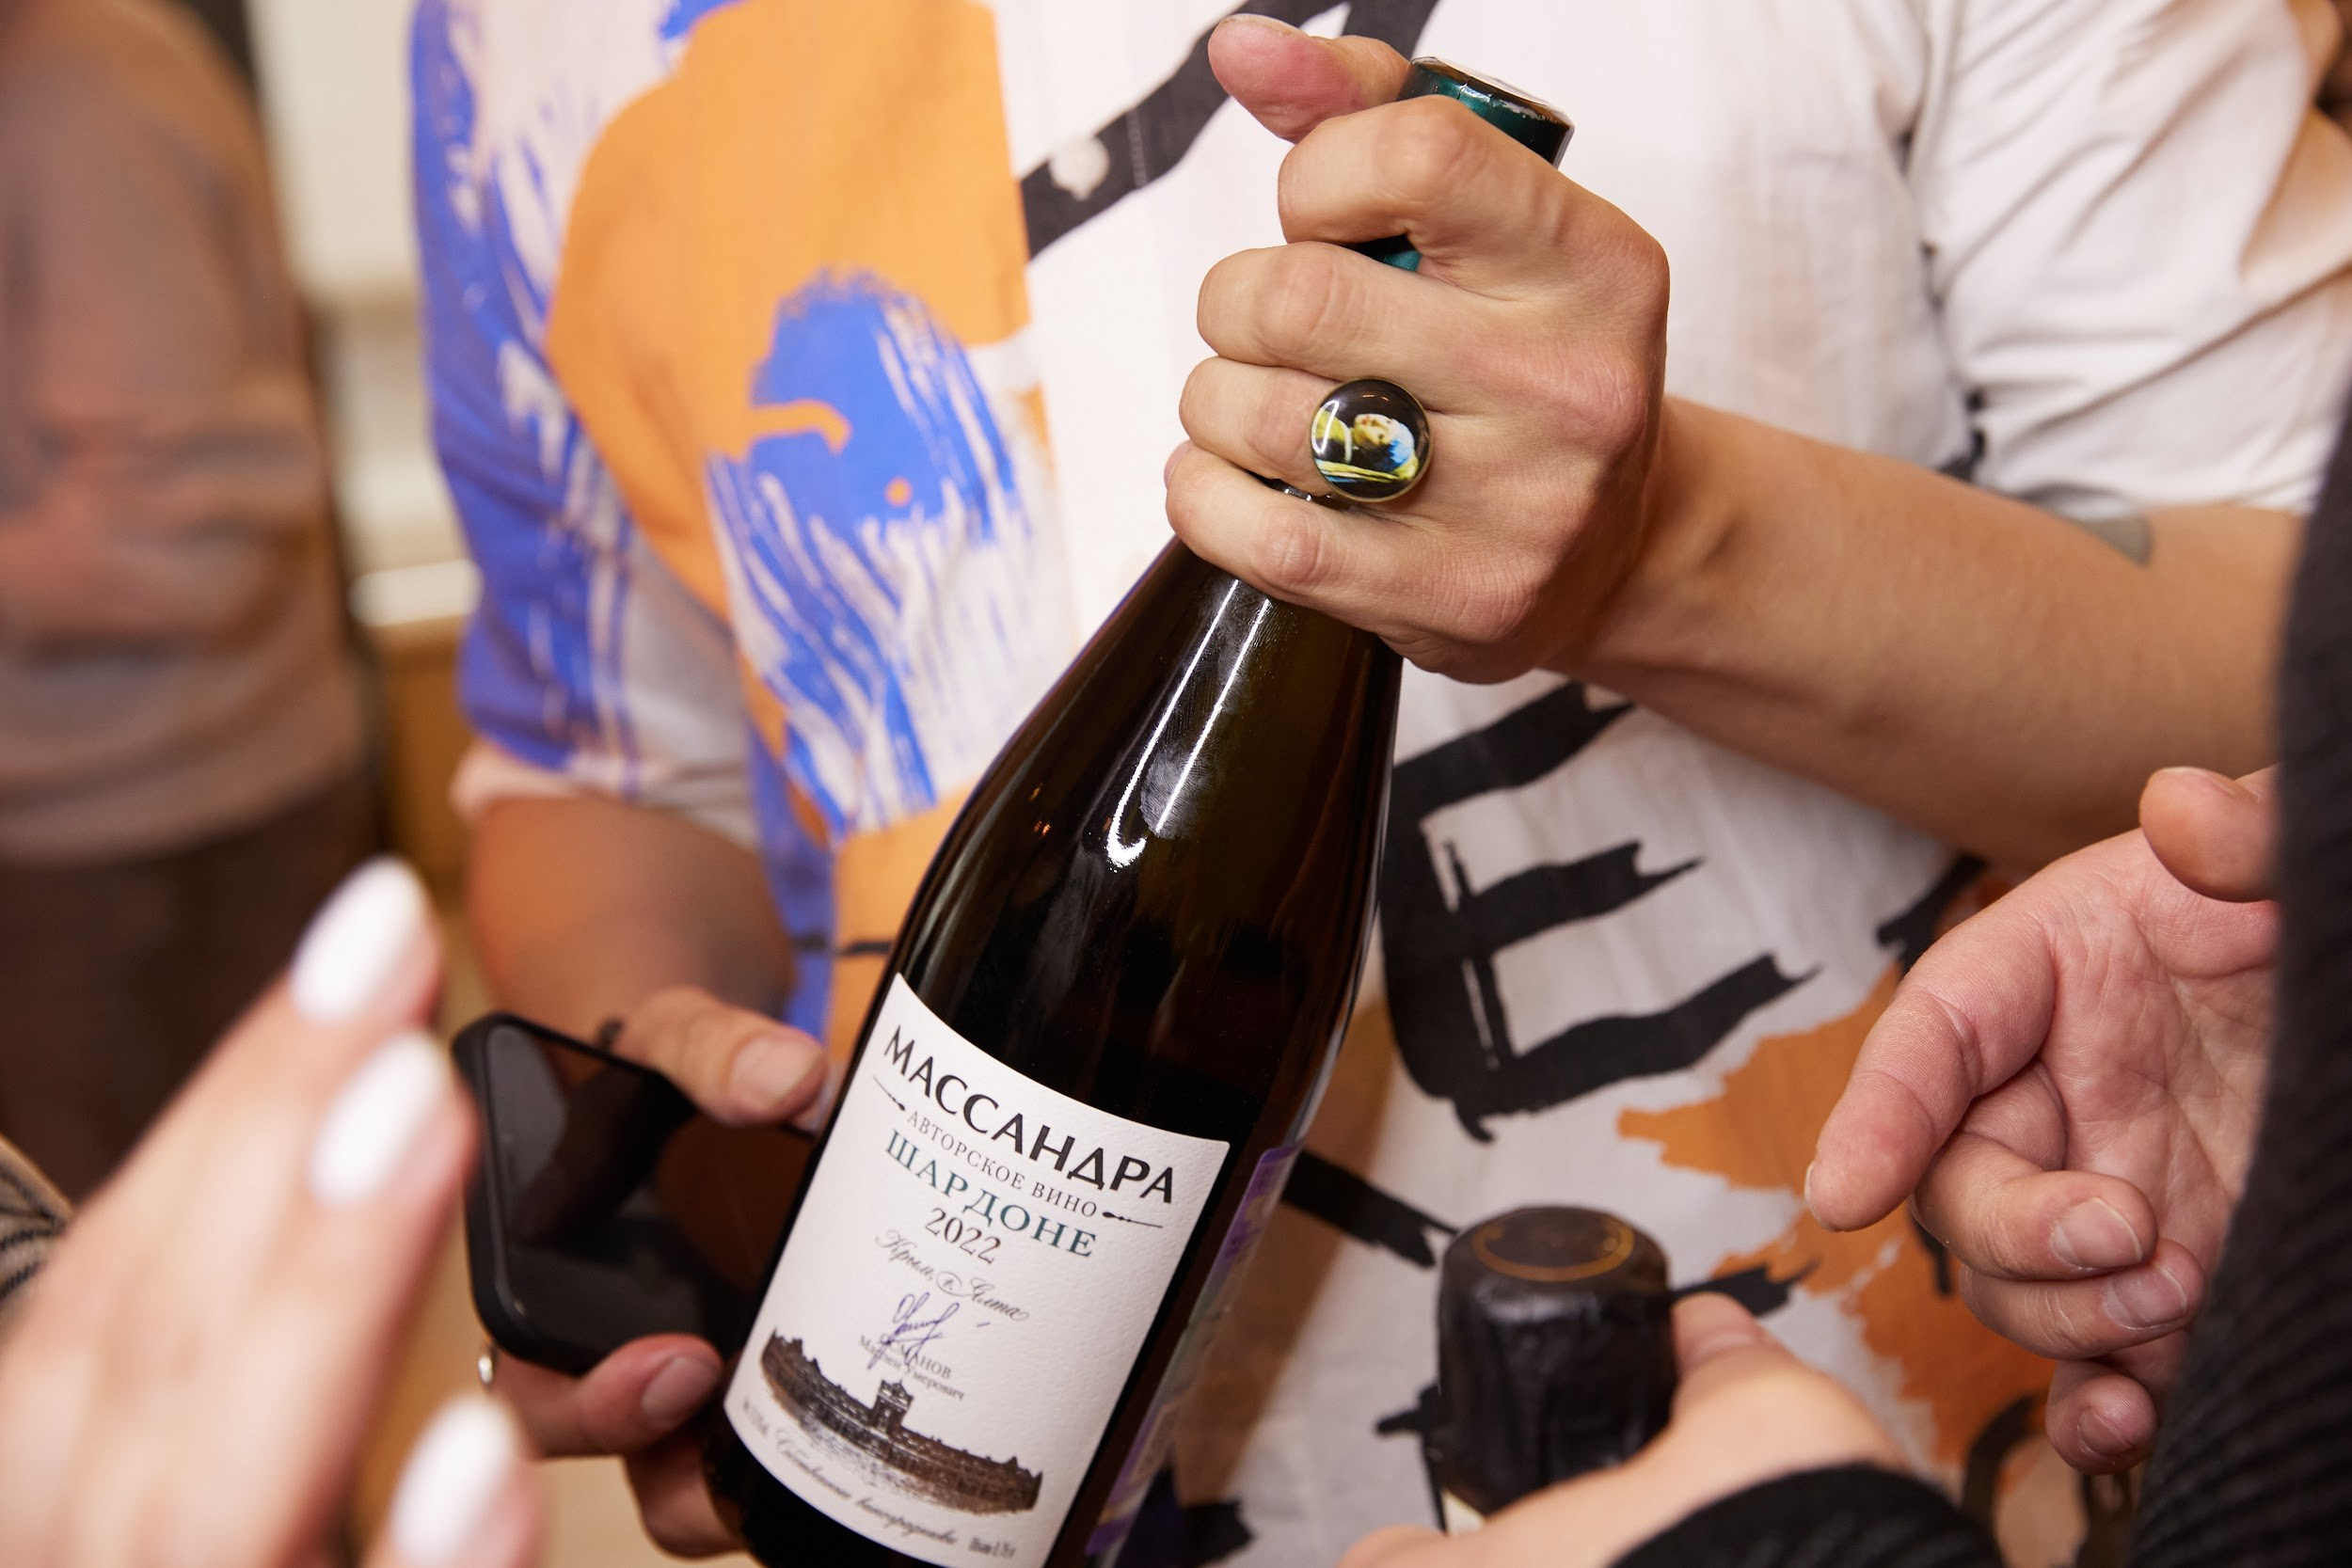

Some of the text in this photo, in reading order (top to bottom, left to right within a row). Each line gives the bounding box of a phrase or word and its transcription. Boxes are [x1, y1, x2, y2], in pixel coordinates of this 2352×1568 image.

[884, 1024, 1173, 1204] МАССАНДРА
[908, 1111, 1097, 1217] АВТОРСКОЕ ВИНО
[885, 1130, 1096, 1258] ШАРДОНЕ
[925, 1208, 1001, 1264] 2022
